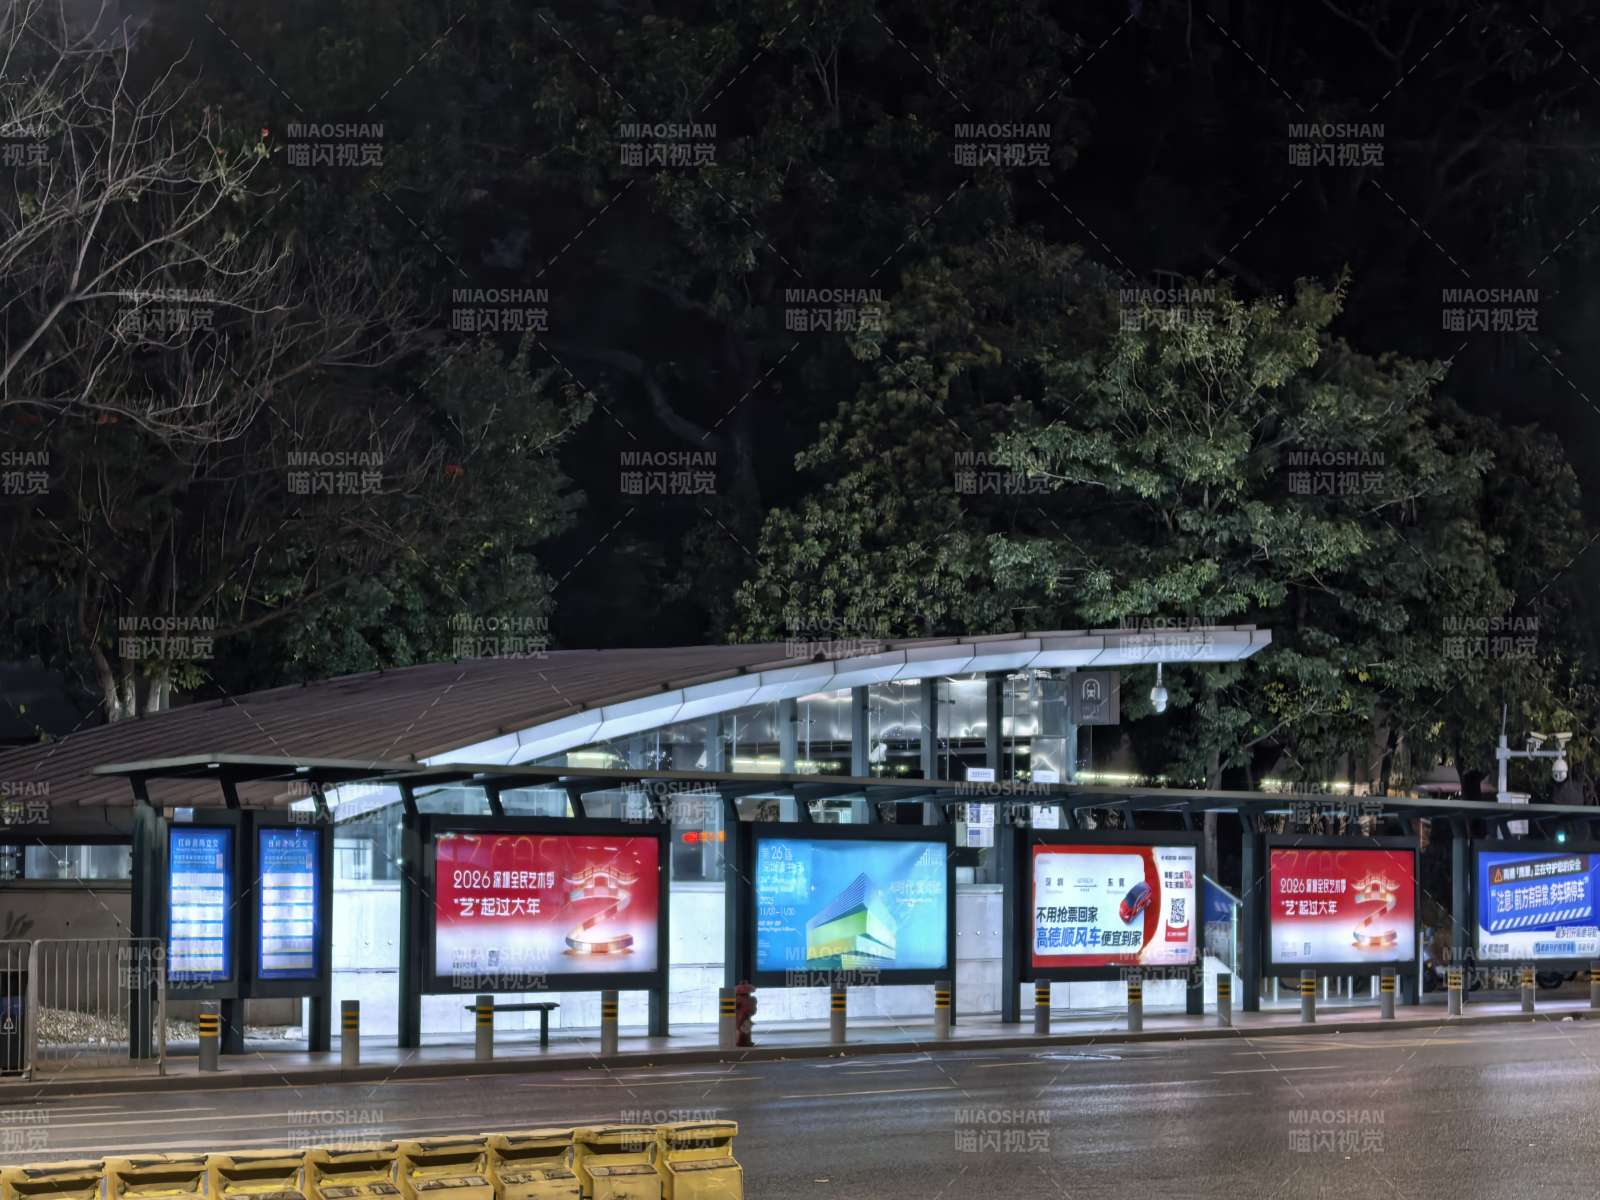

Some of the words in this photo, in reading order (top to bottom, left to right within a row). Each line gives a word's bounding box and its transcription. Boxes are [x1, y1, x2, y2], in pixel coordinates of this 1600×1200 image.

[1036, 906, 1098, 923] 不用抢票回家
[1036, 926, 1142, 949] 高德顺风车便宜到家
